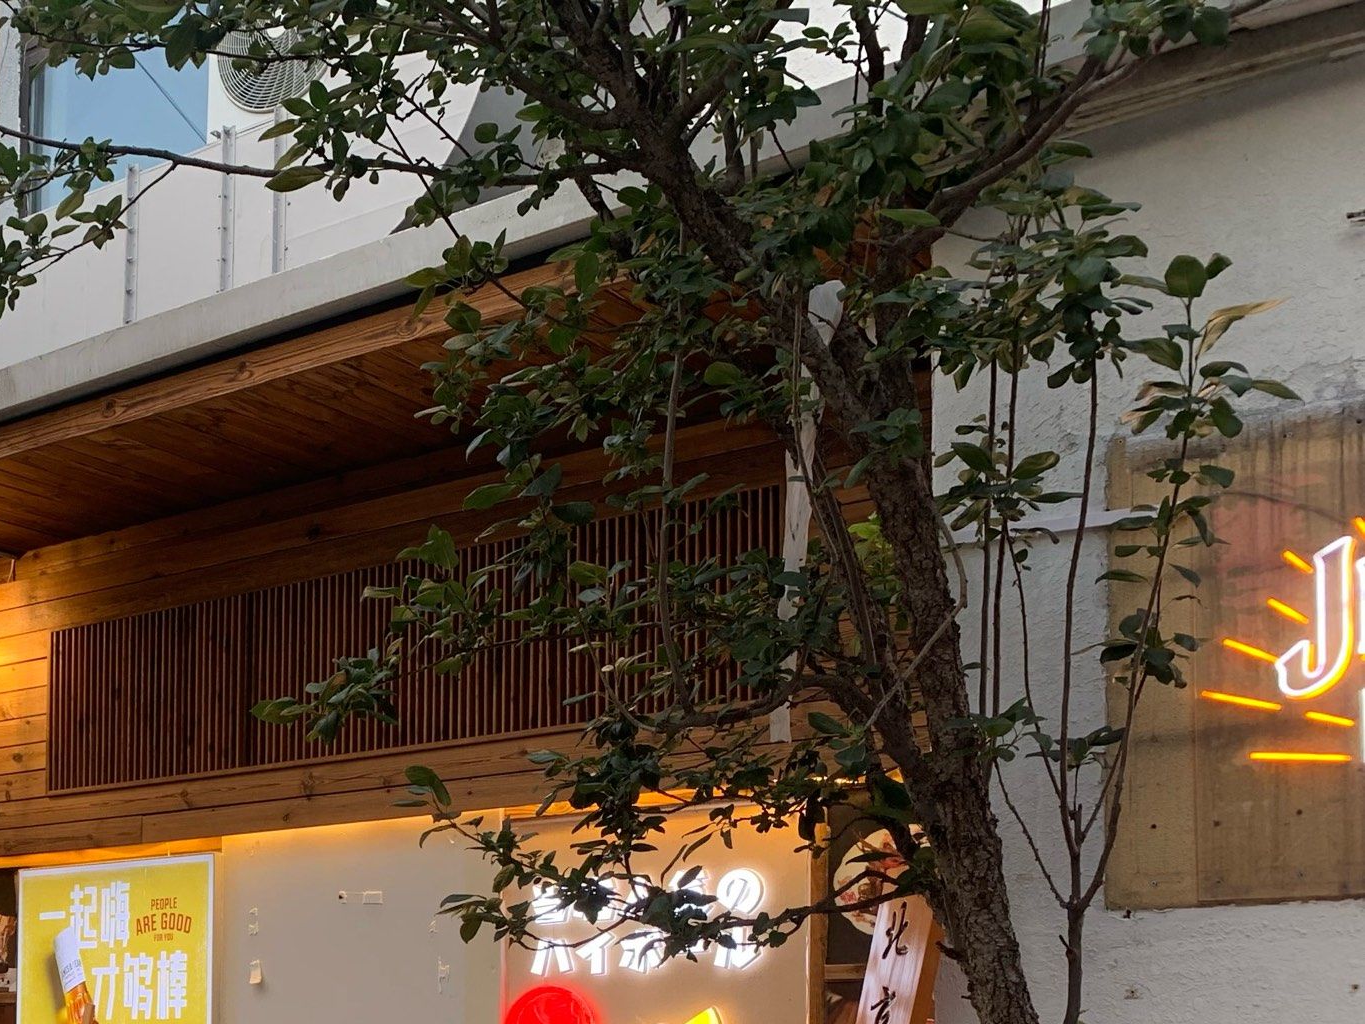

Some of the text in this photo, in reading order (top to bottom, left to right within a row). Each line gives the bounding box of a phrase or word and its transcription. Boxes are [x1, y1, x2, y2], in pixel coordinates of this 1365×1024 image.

[39, 880, 131, 949] 一起嗨
[151, 897, 178, 911] PEOPLE
[136, 912, 192, 936] ARE GOOD
[154, 933, 174, 942] FOR YOU
[91, 950, 188, 1020] 才够棒
